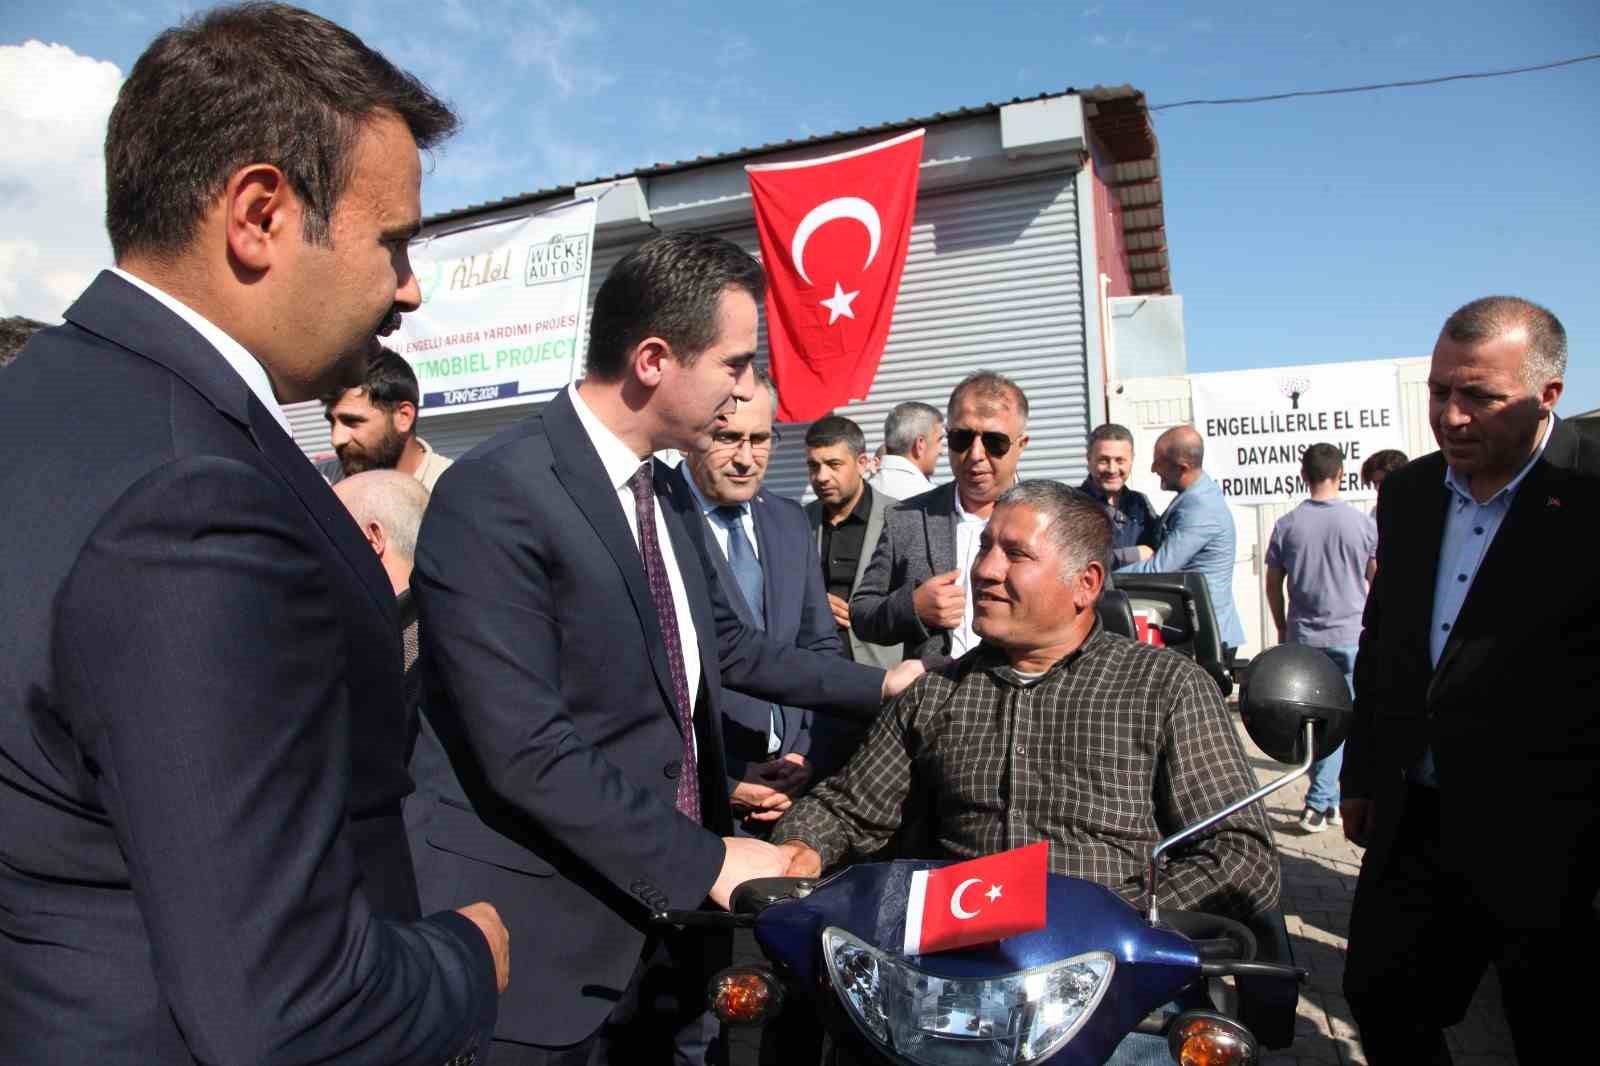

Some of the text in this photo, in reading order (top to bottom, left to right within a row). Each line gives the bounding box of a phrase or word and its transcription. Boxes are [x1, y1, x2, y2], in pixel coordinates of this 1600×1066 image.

[446, 331, 480, 346] ARABA
[411, 338, 577, 379] TMOBIEL PROJECT
[1206, 408, 1390, 437] ENGELLİLERLE EL ELE
[1338, 441, 1360, 460] VE
